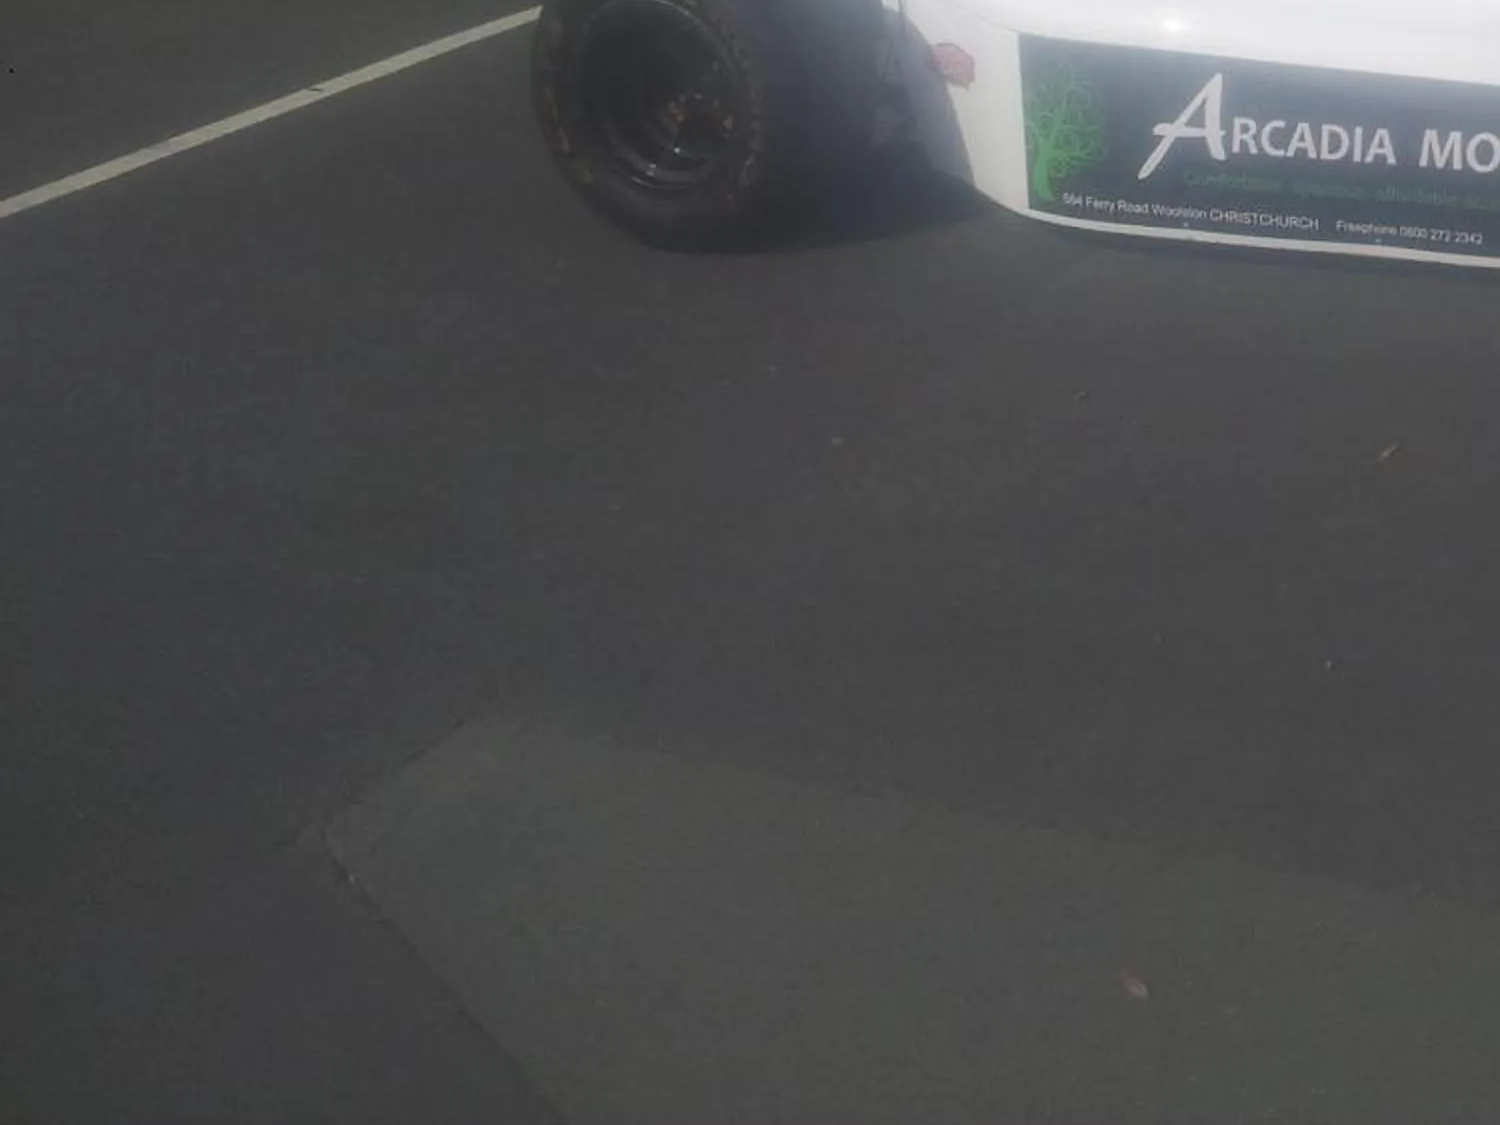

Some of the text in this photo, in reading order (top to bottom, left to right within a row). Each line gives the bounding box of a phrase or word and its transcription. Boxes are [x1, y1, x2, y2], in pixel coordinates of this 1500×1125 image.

[1137, 72, 1398, 180] ARCADIA
[1085, 195, 1115, 212] Ferry
[1117, 199, 1149, 216] Road
[1209, 208, 1320, 231] CHRISTCHURCH
